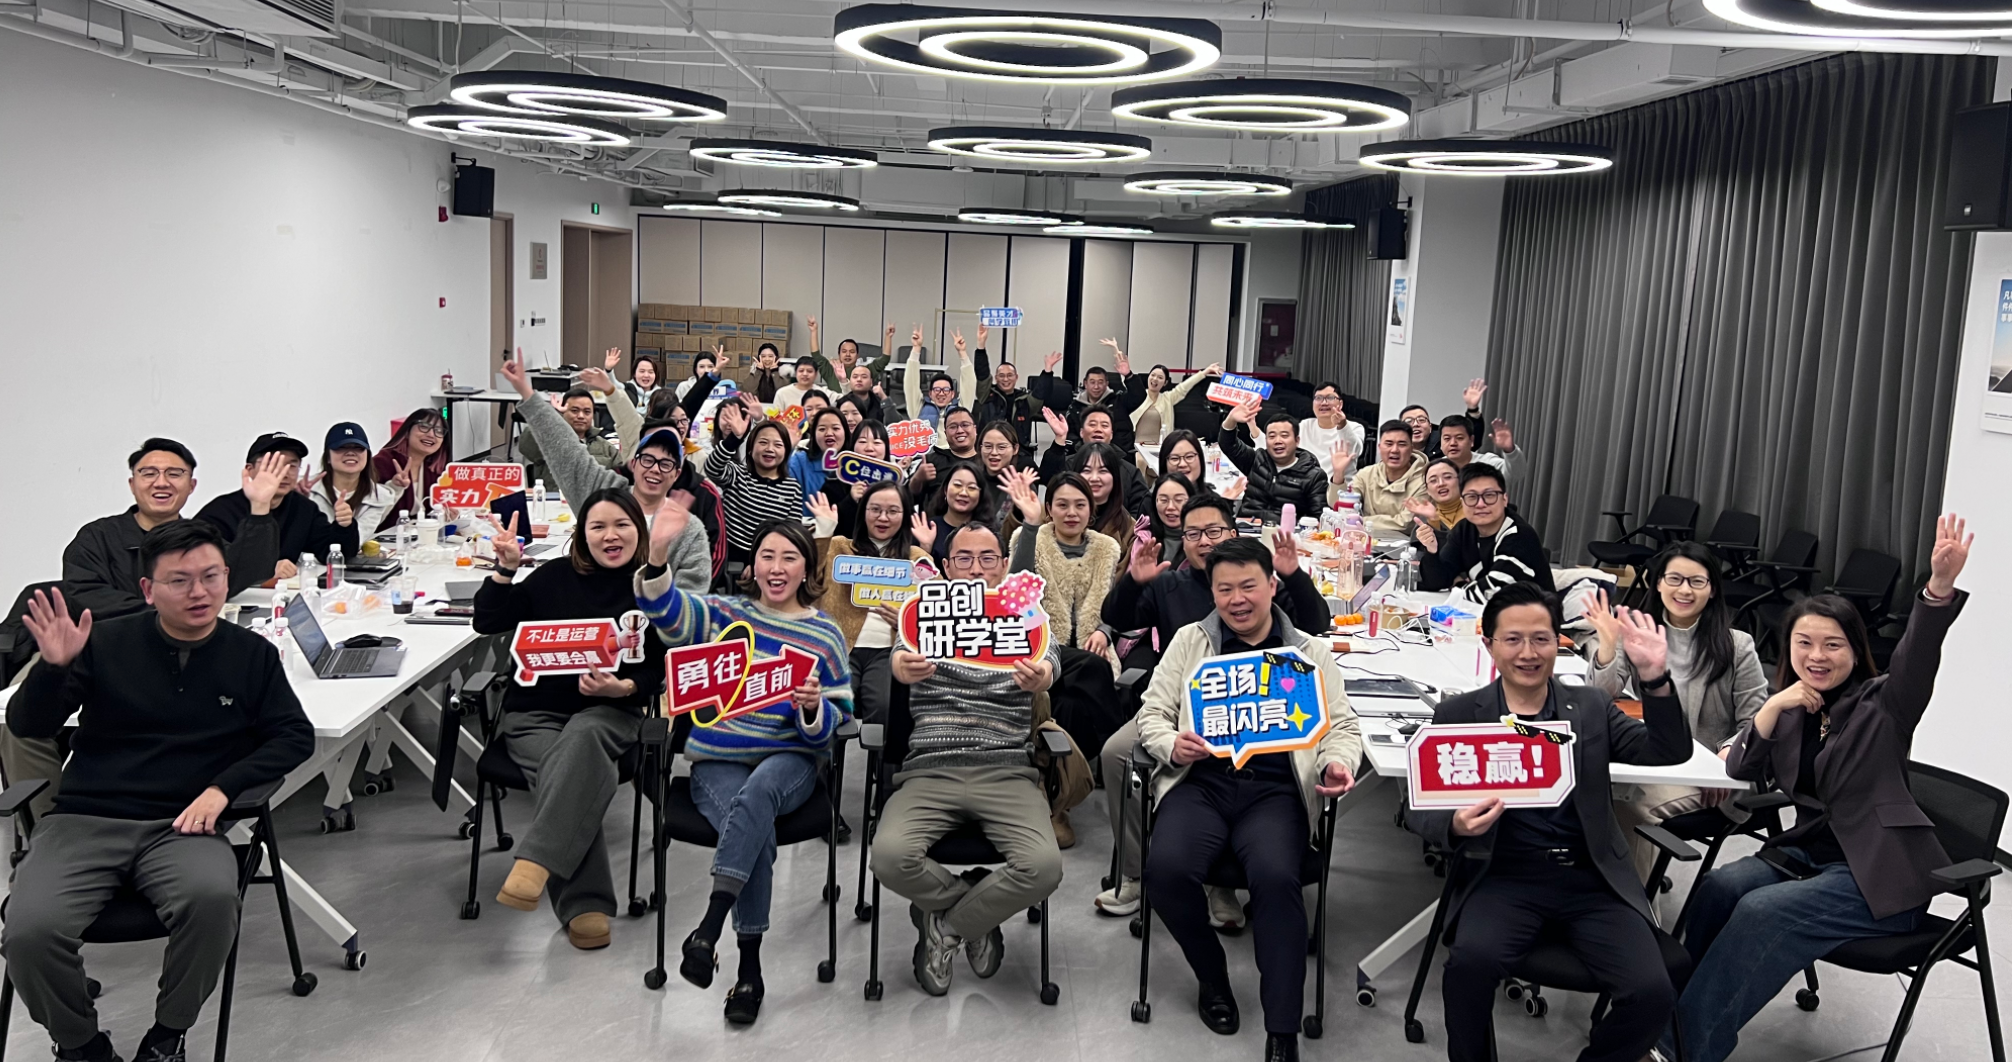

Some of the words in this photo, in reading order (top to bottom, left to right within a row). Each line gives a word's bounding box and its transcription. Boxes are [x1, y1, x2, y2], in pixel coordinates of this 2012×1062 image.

[1222, 374, 1265, 392] 同心同行
[454, 466, 520, 481] 做真正的
[839, 562, 907, 578] 做事赢在细节
[918, 583, 983, 618] 品创
[526, 626, 600, 643] 不止是运营
[918, 617, 1031, 658] 研学堂
[1202, 698, 1289, 737] 最闪亮
[1436, 741, 1544, 786] 稳赢!
